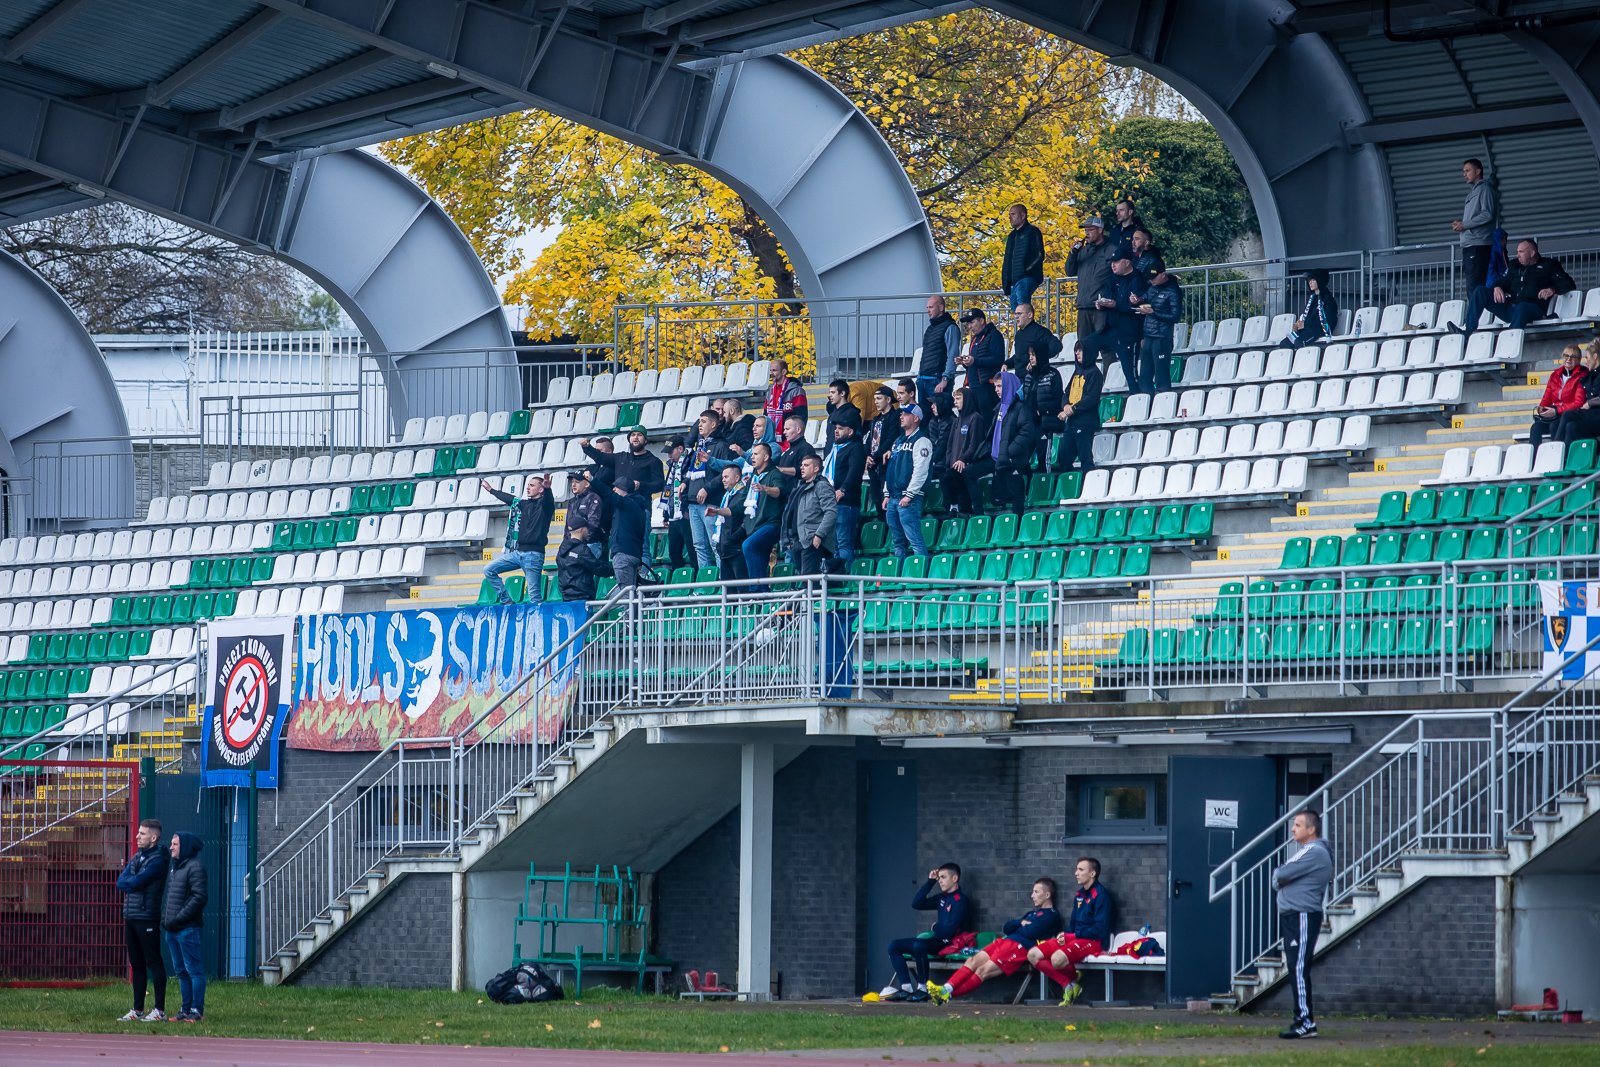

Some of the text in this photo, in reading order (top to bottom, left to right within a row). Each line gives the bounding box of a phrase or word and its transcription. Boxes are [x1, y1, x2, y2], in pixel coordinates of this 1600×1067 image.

[218, 638, 278, 687] PRECZ Z KOMUNA!
[300, 610, 408, 704] HOOLS
[256, 714, 275, 746] GÓRA
[1213, 807, 1231, 817] WC
